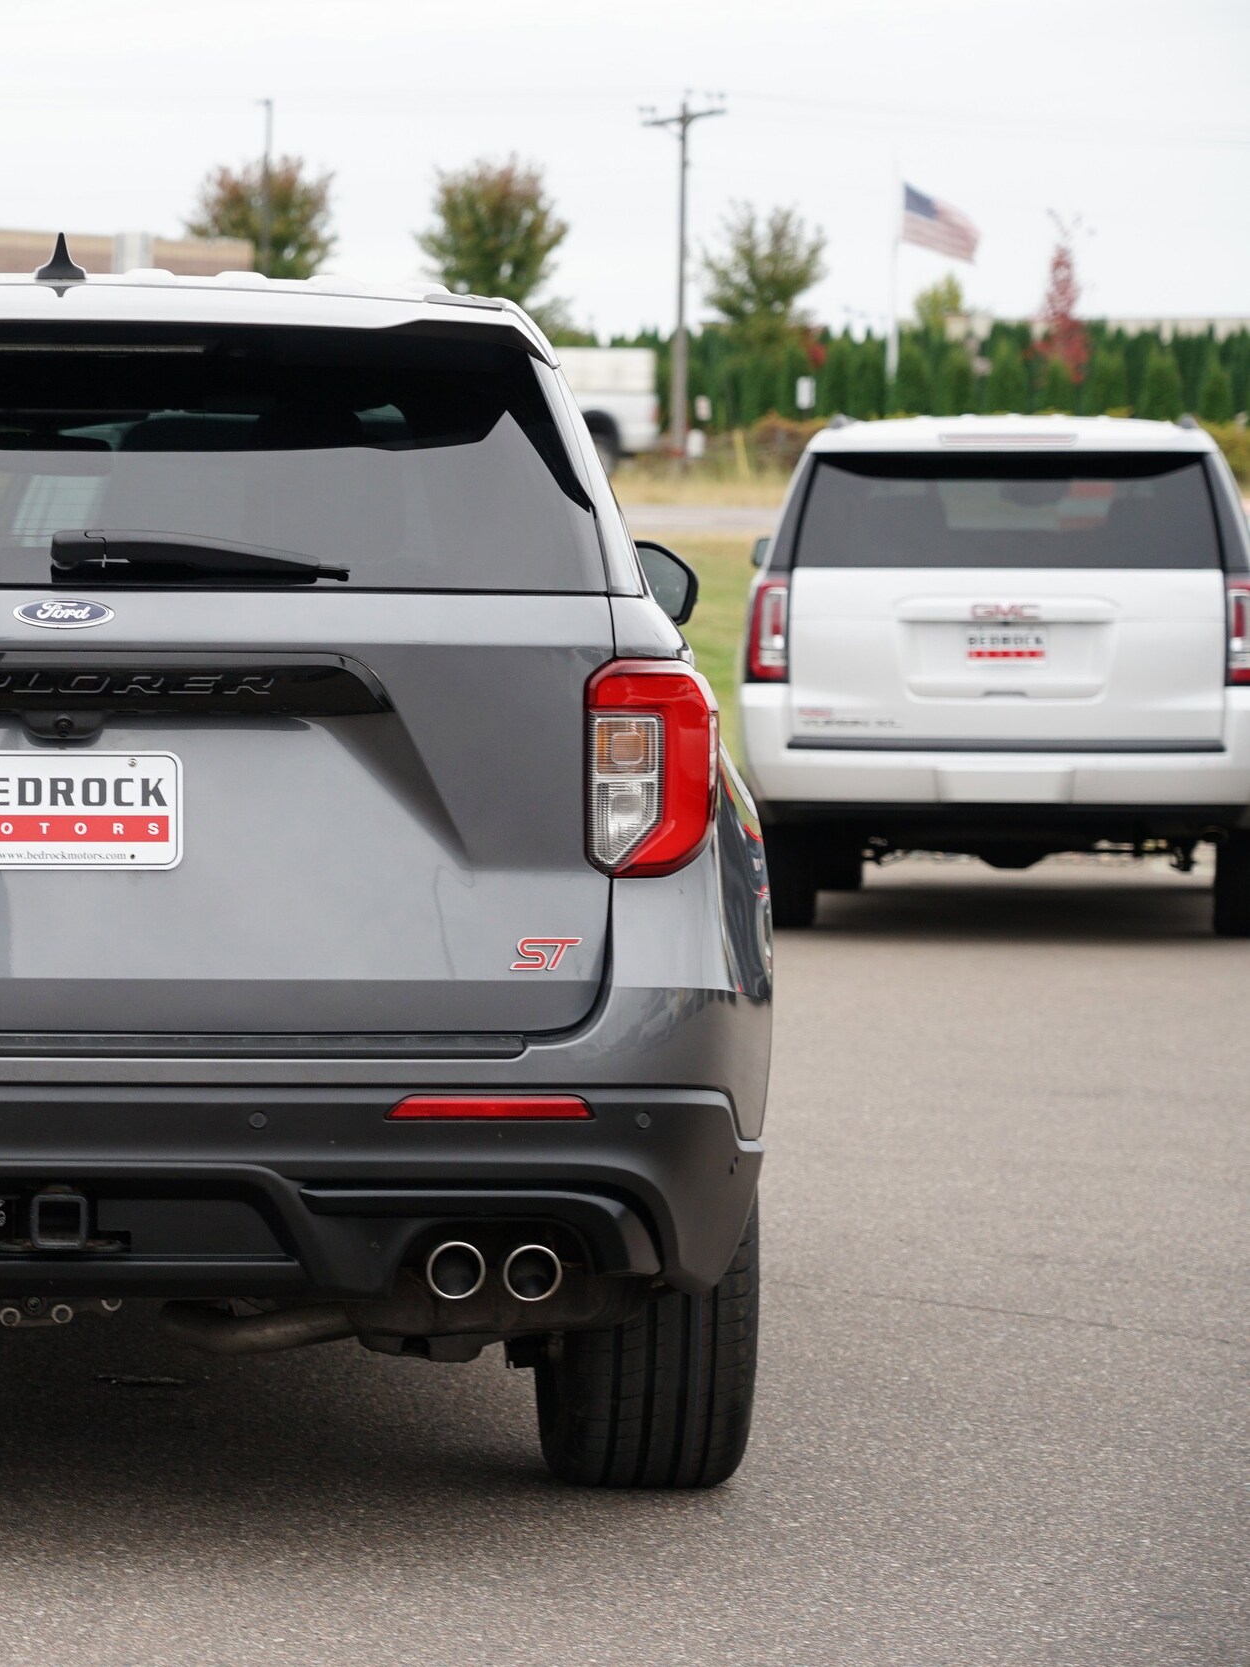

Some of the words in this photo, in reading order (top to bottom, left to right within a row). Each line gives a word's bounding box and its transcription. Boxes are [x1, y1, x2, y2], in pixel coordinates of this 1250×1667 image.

[36, 601, 90, 620] Ford
[971, 604, 1040, 620] GMC
[510, 937, 583, 971] ST
